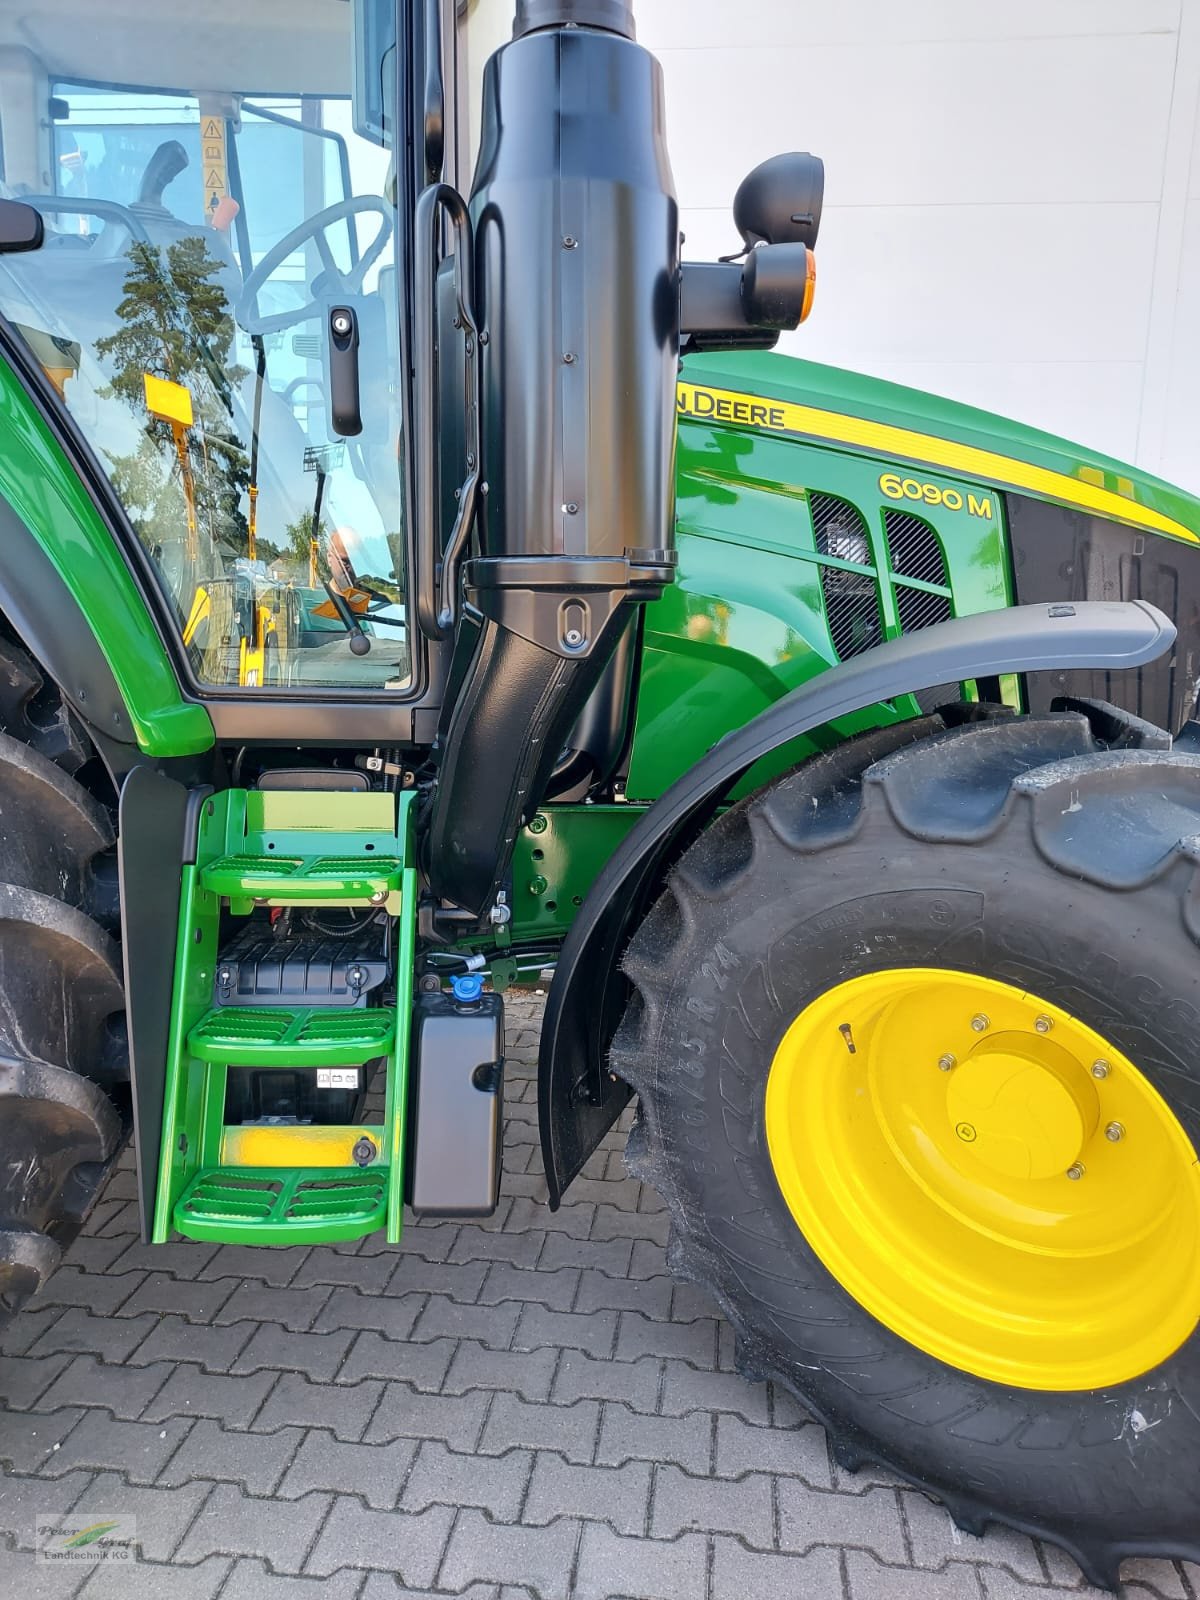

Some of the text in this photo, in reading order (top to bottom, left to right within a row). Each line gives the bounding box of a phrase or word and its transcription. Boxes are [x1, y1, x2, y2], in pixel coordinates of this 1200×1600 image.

[693, 391, 785, 427] DEERE
[878, 472, 993, 520] 6090 M
